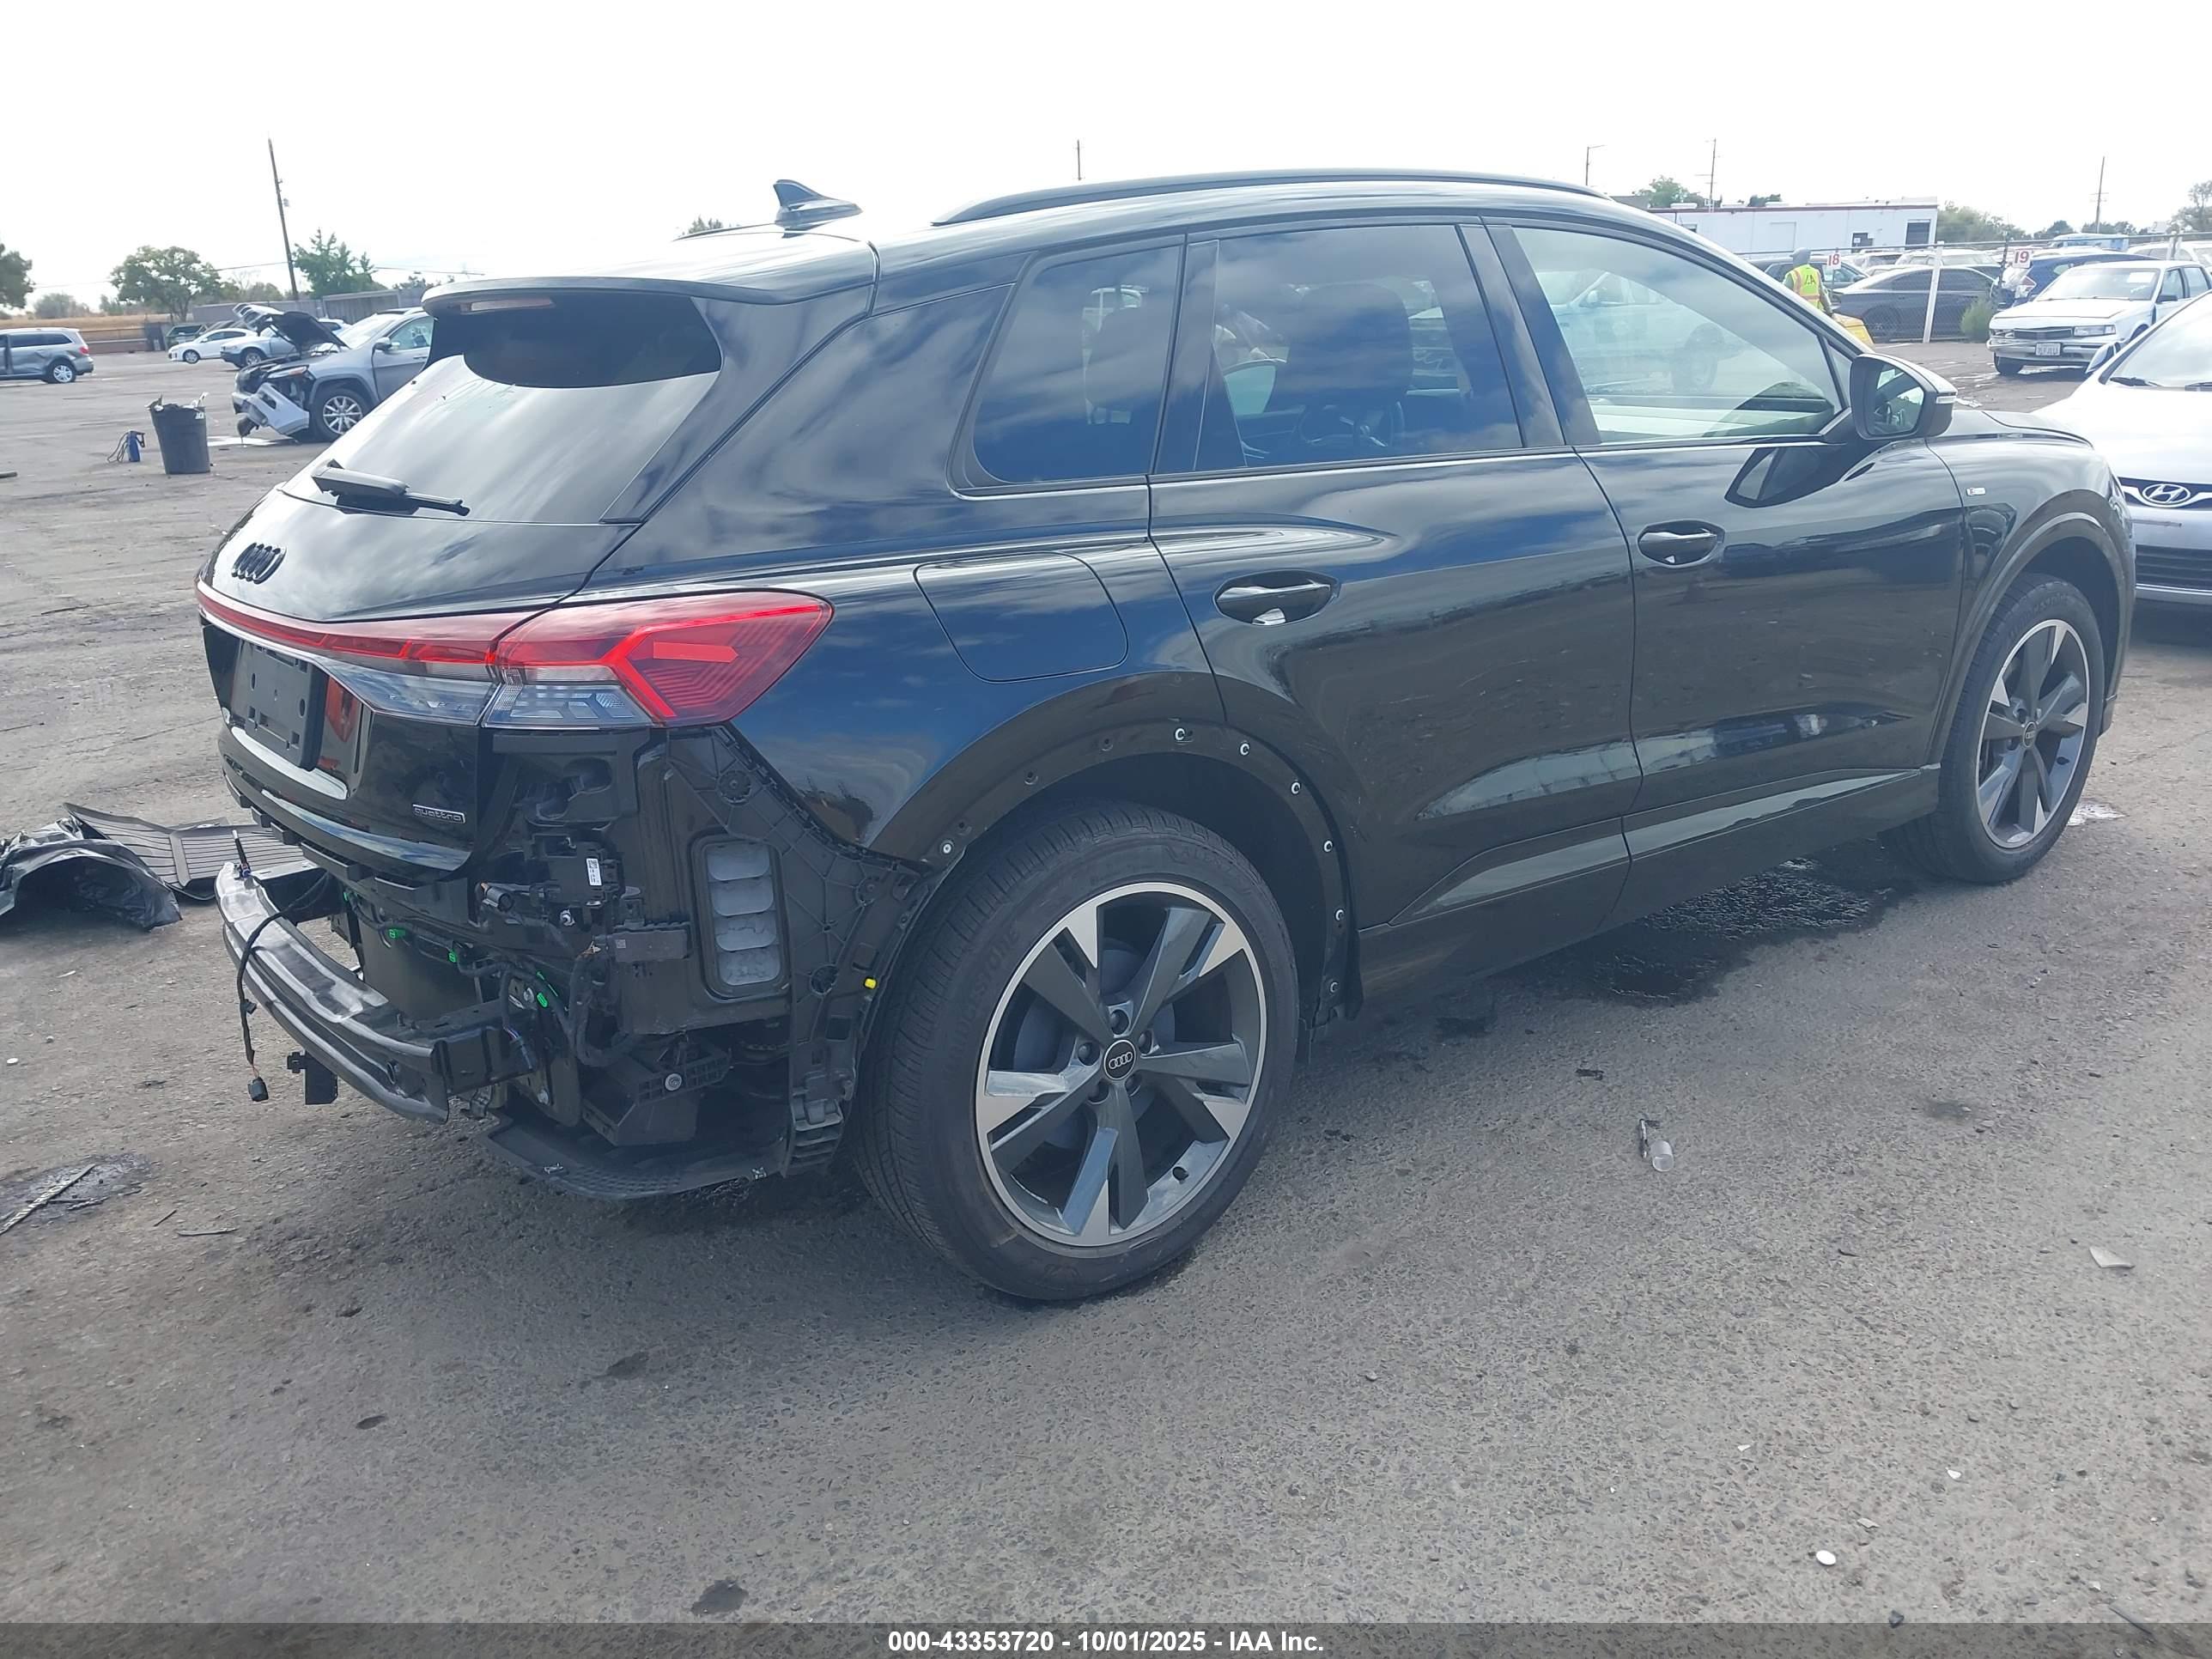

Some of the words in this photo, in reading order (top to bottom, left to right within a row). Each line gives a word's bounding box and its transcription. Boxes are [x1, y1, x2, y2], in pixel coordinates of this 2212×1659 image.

[1827, 253, 1840, 266] 18
[2014, 251, 2030, 264] 19
[415, 807, 462, 822] quattro
